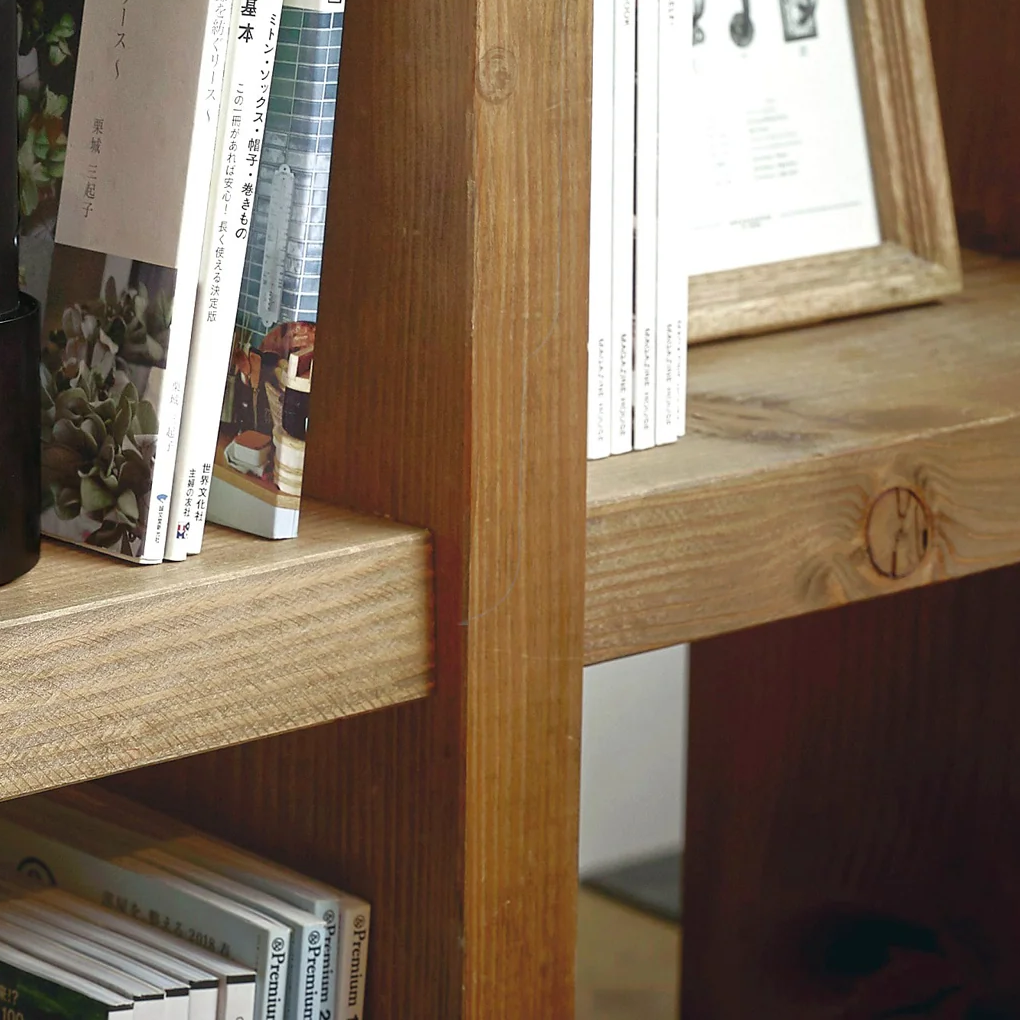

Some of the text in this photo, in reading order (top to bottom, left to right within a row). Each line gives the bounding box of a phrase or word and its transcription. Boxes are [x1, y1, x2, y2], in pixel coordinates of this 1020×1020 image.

[194, 463, 211, 521] 世界文化社
